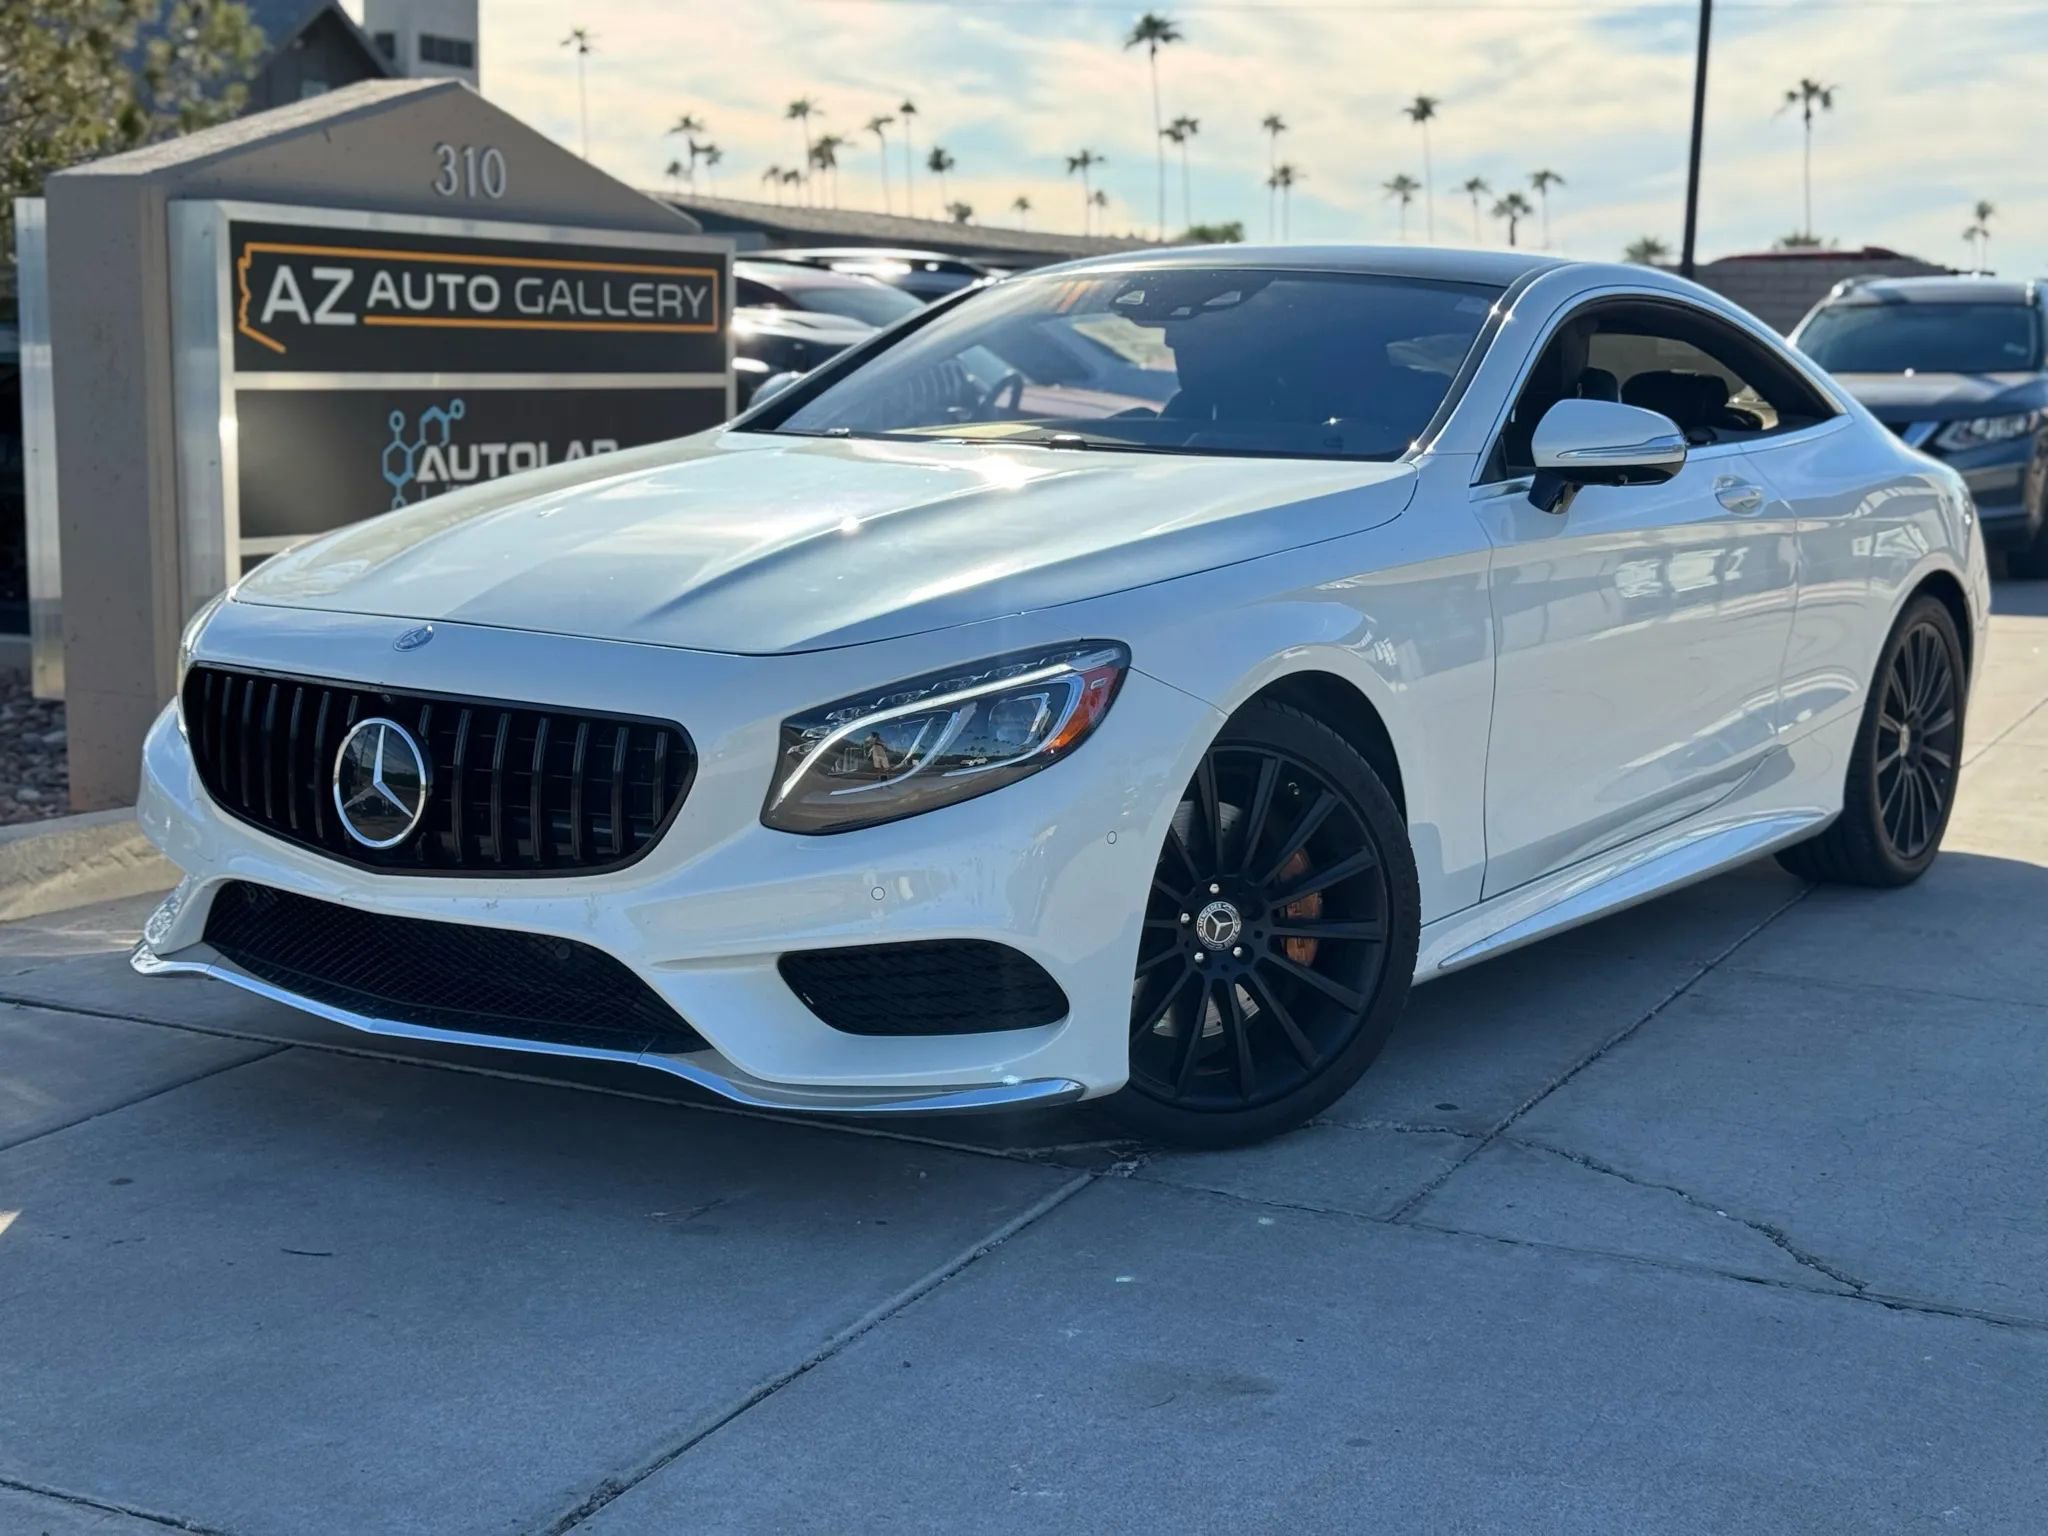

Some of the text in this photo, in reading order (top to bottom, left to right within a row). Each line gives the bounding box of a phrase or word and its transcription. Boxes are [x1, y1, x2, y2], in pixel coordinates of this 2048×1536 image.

[434, 143, 507, 199] 310
[260, 264, 708, 326] AZ AUTO GALLERY
